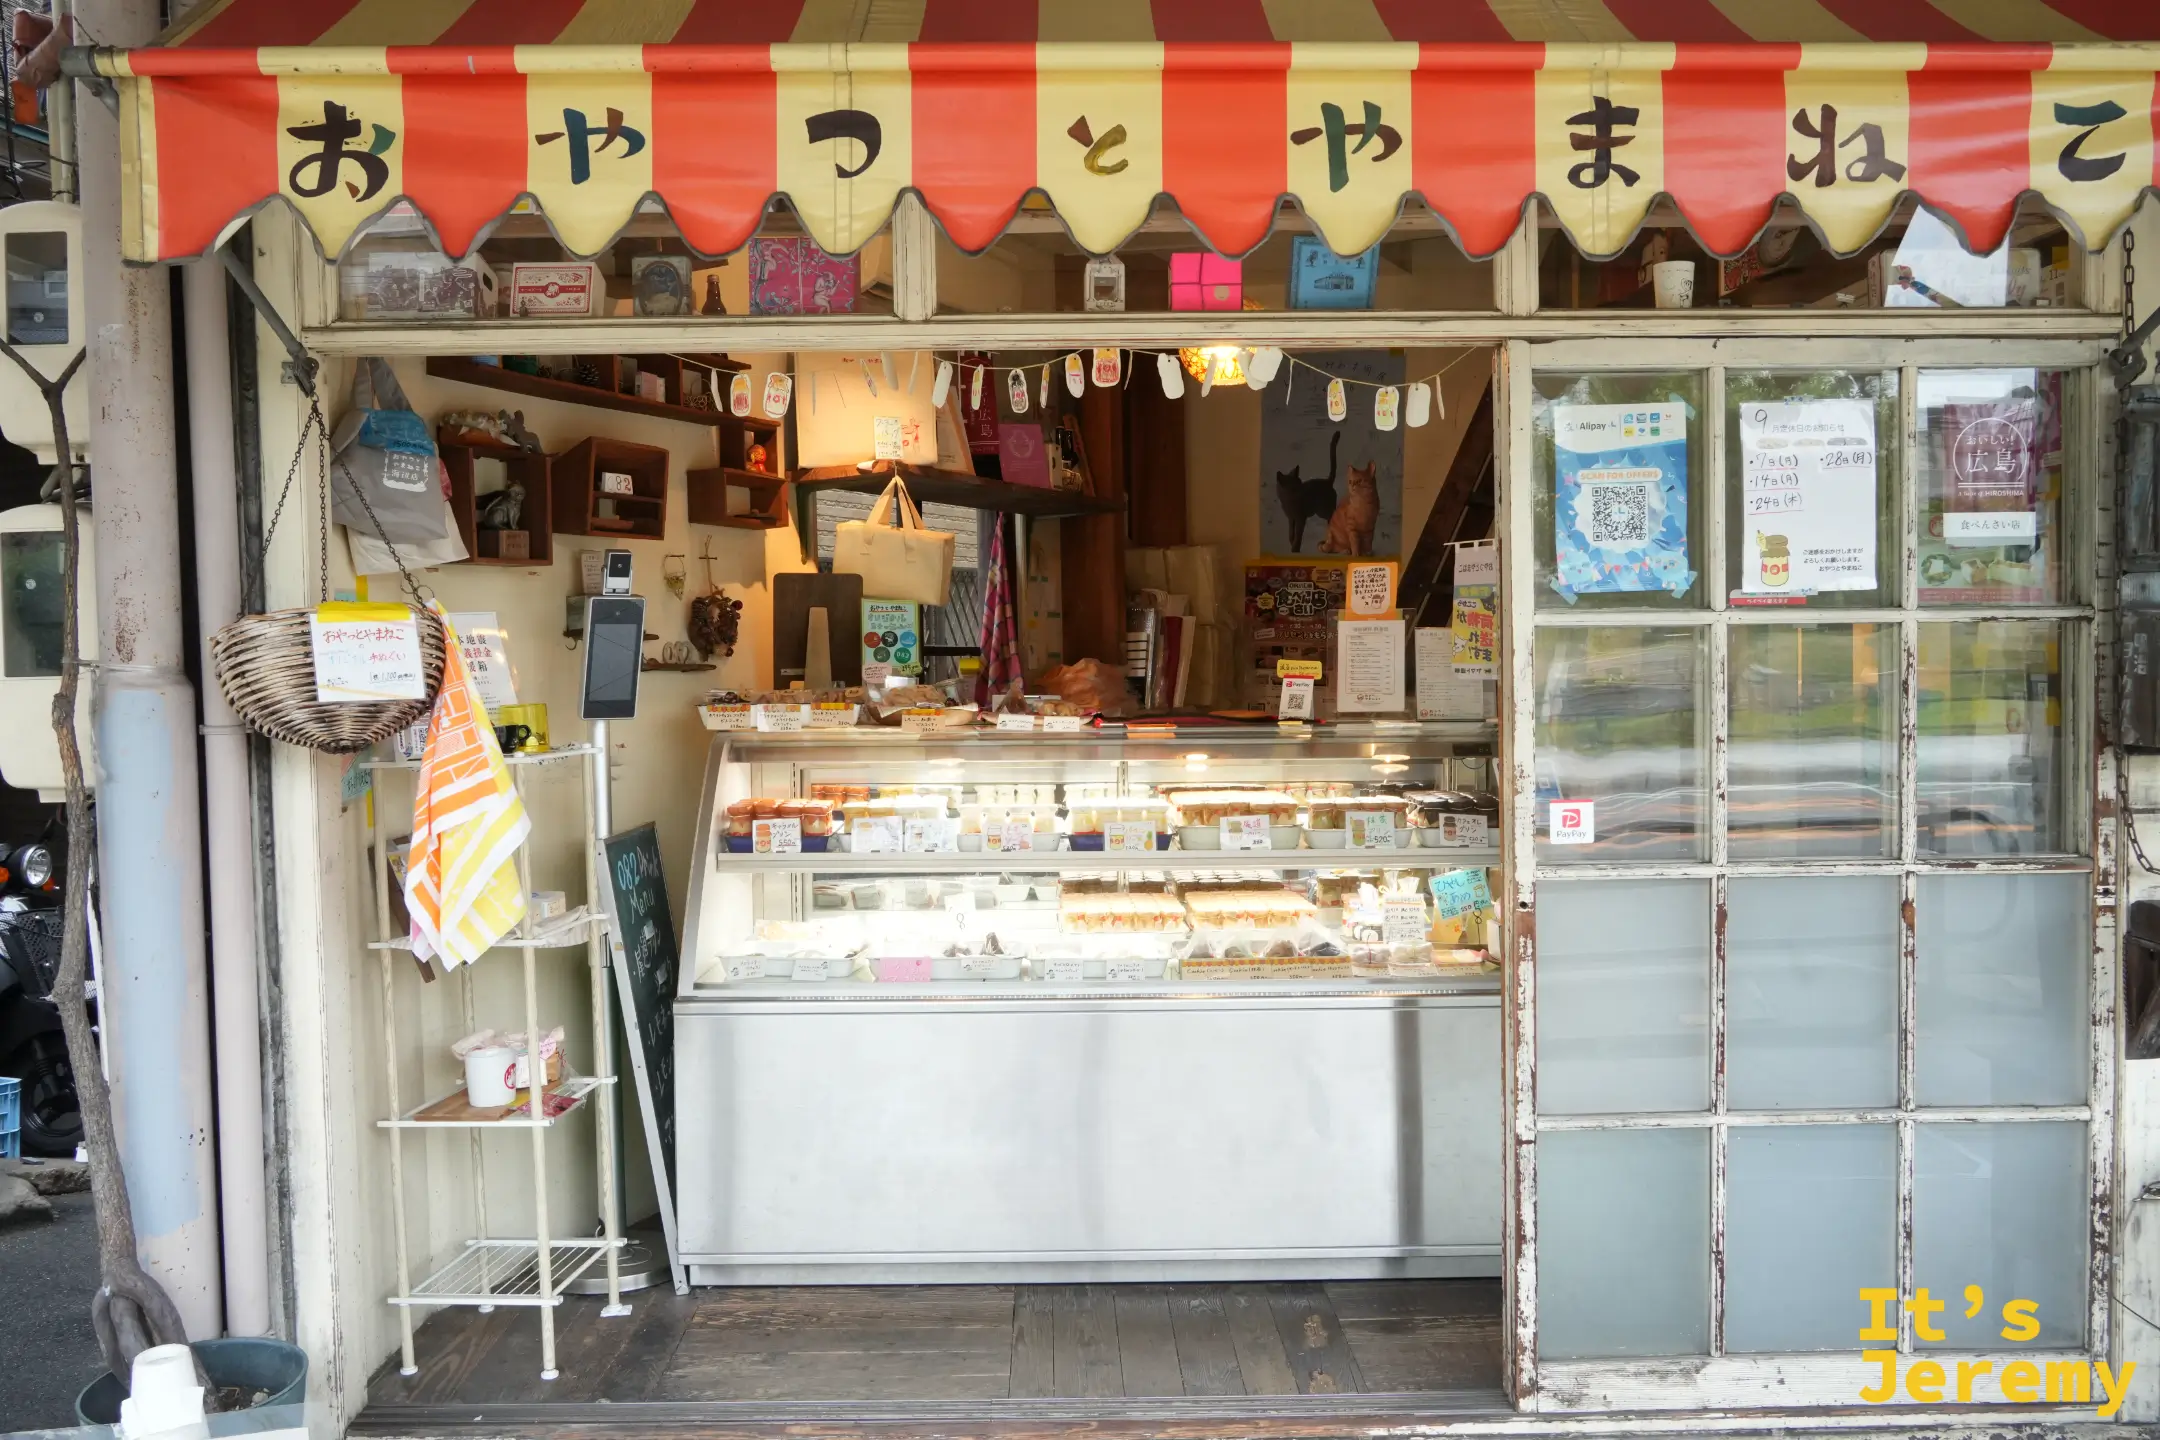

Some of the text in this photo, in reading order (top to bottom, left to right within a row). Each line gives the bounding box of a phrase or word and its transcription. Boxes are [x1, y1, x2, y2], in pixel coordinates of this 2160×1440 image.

[1579, 422, 1607, 431] Alipay
[1965, 448, 2016, 474] 広島
[1580, 470, 1659, 481] SCAN FOR OFFERS
[1961, 519, 2021, 531] 食べんさい店
[1556, 830, 1587, 838] PayPay
[617, 845, 660, 891] 082 Drink
[629, 888, 655, 924] Menu
